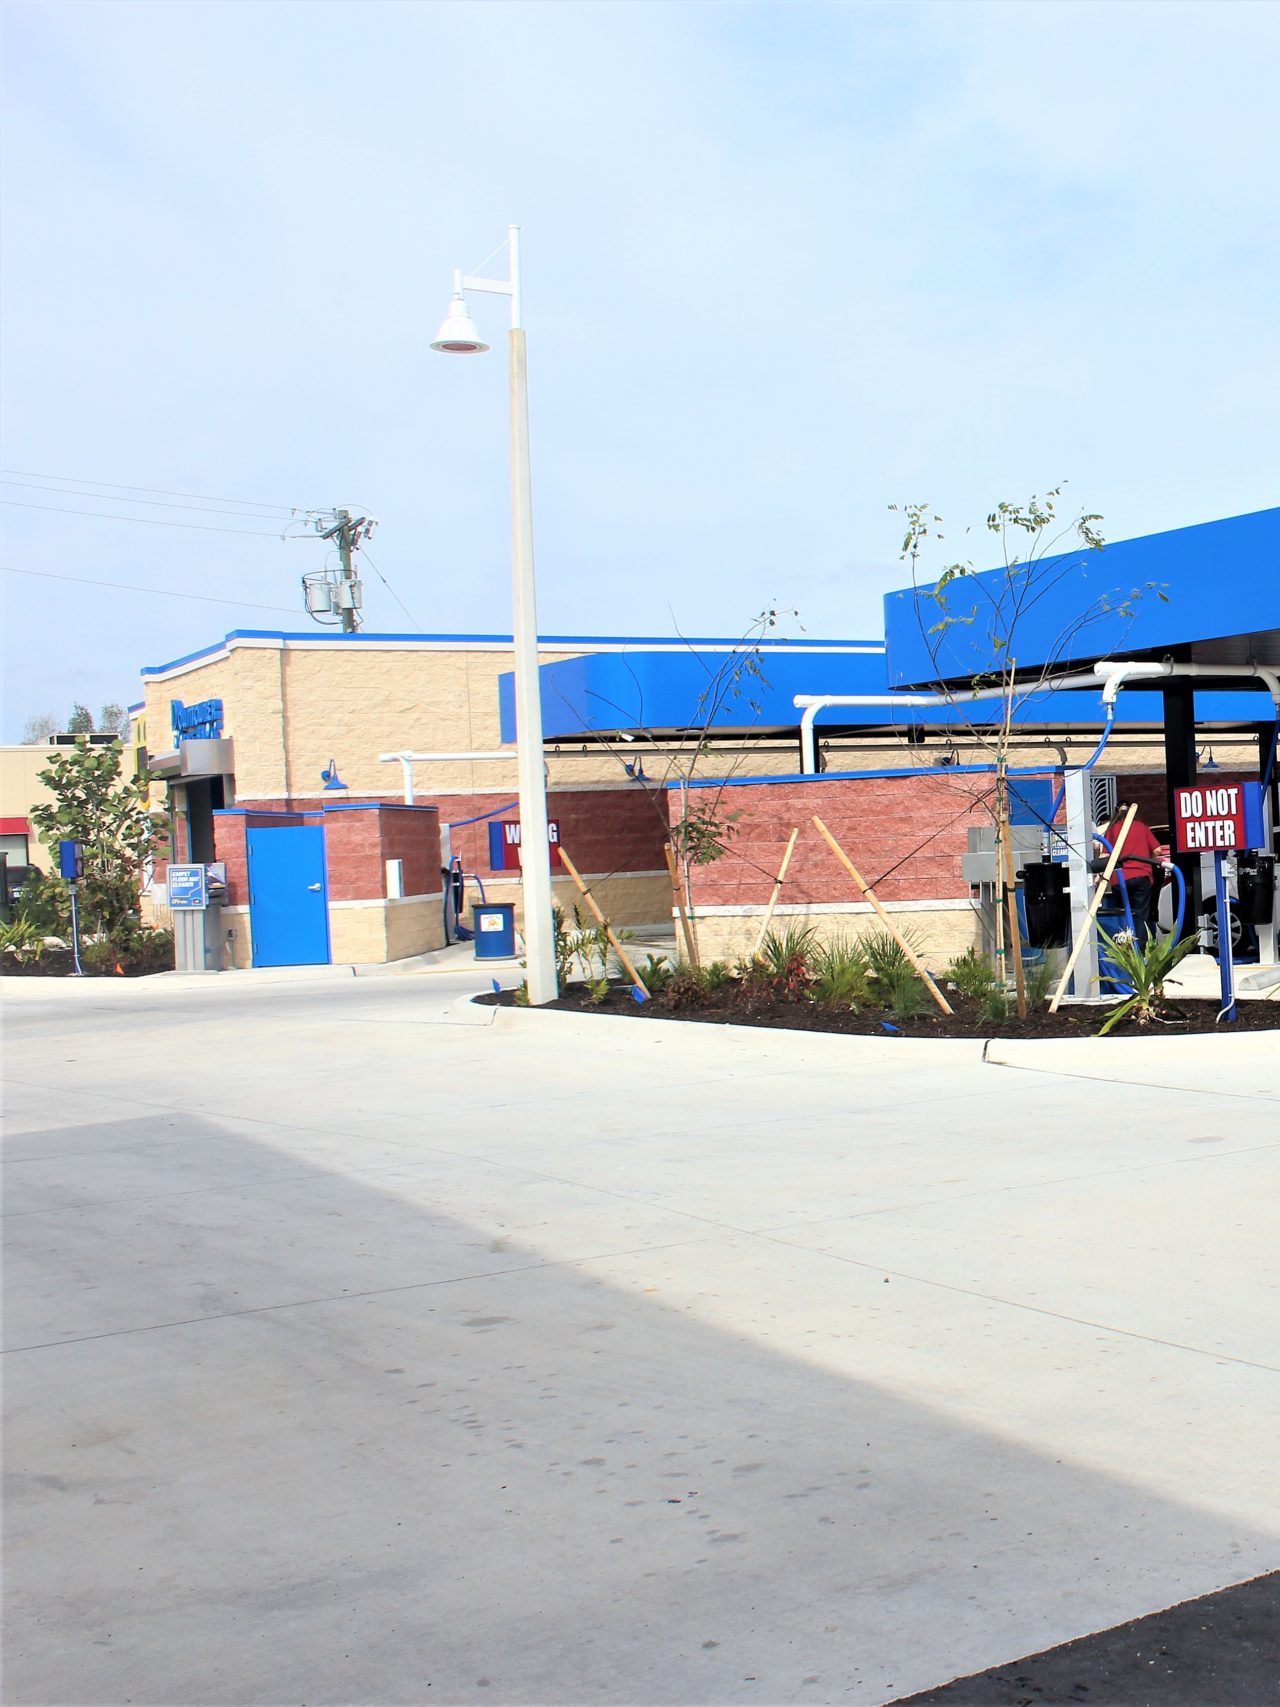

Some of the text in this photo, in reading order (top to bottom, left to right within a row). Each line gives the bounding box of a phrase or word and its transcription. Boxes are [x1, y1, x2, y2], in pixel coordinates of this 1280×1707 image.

[1180, 787, 1238, 818] DO NOT
[1186, 820, 1236, 848] ENTER
